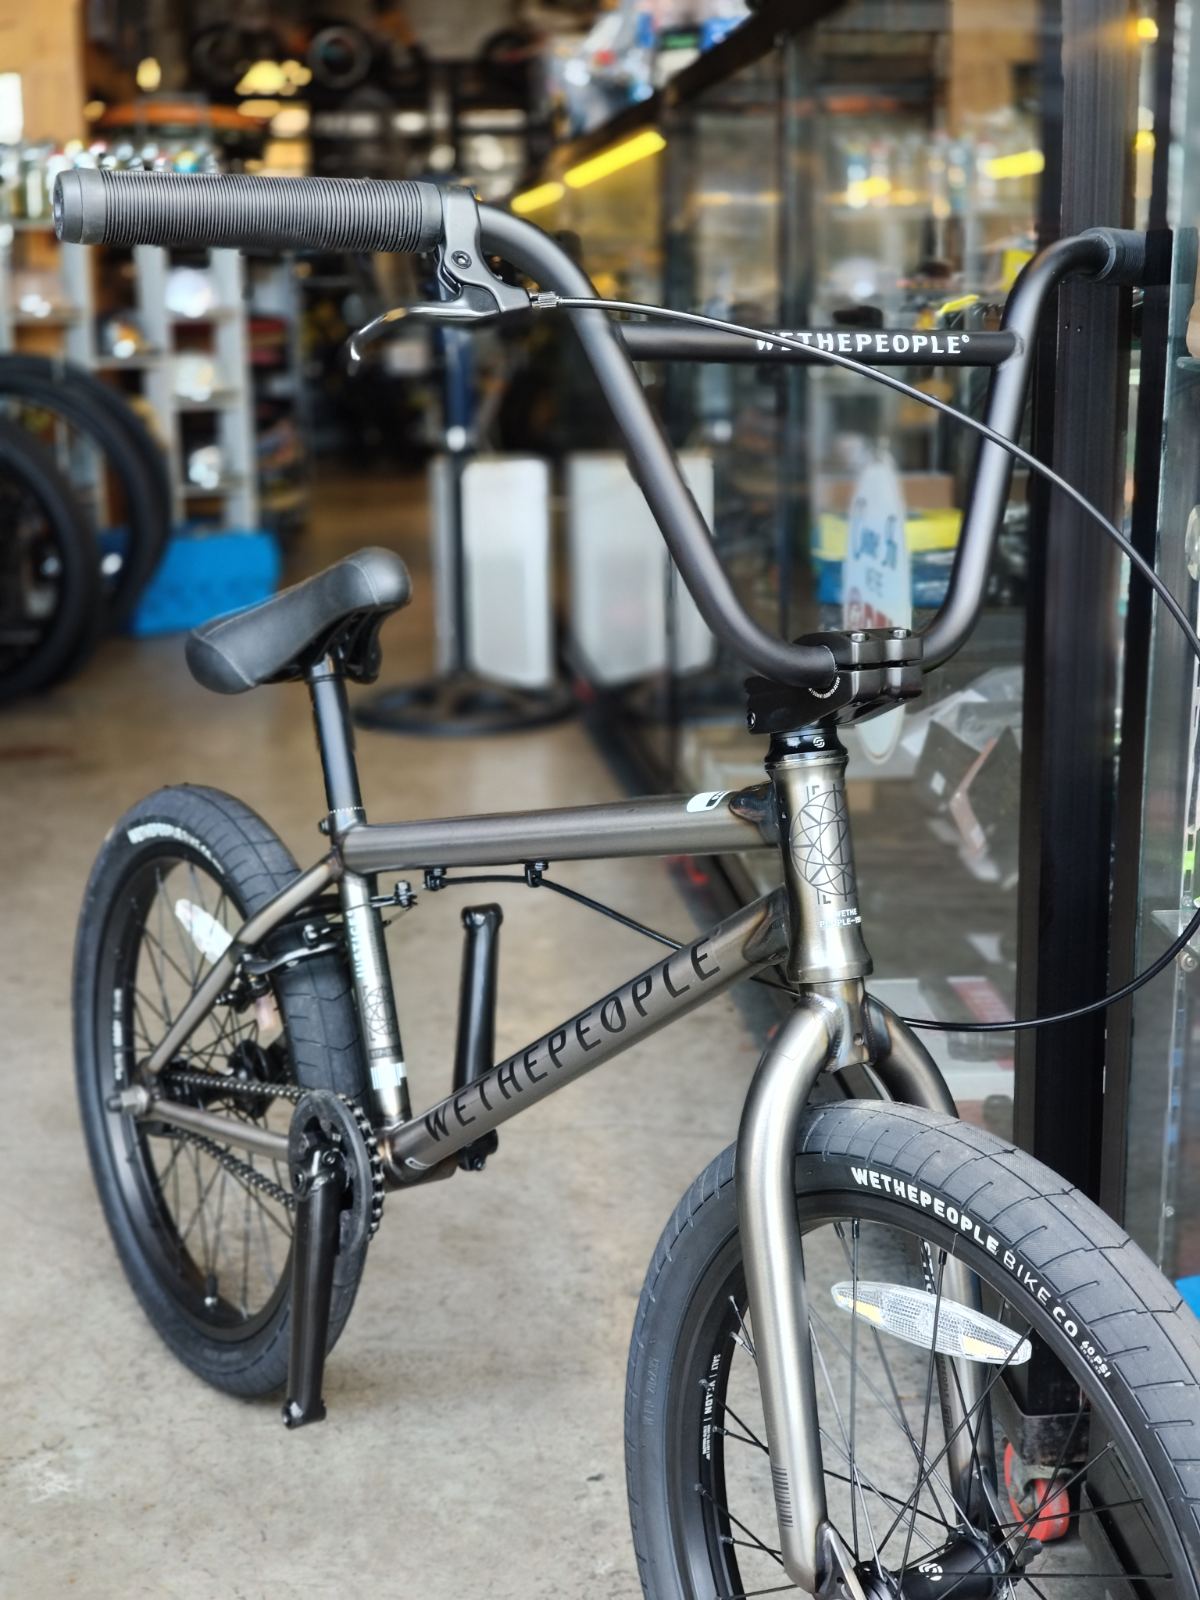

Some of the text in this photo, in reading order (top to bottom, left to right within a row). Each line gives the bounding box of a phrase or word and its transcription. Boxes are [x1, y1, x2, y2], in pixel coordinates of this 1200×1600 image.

[424, 937, 720, 1142] WETHEPEOPLE
[850, 1166, 999, 1257] WETHEPEOPLE
[1003, 1250, 1052, 1307] BIKE
[1052, 1306, 1078, 1338] CO
